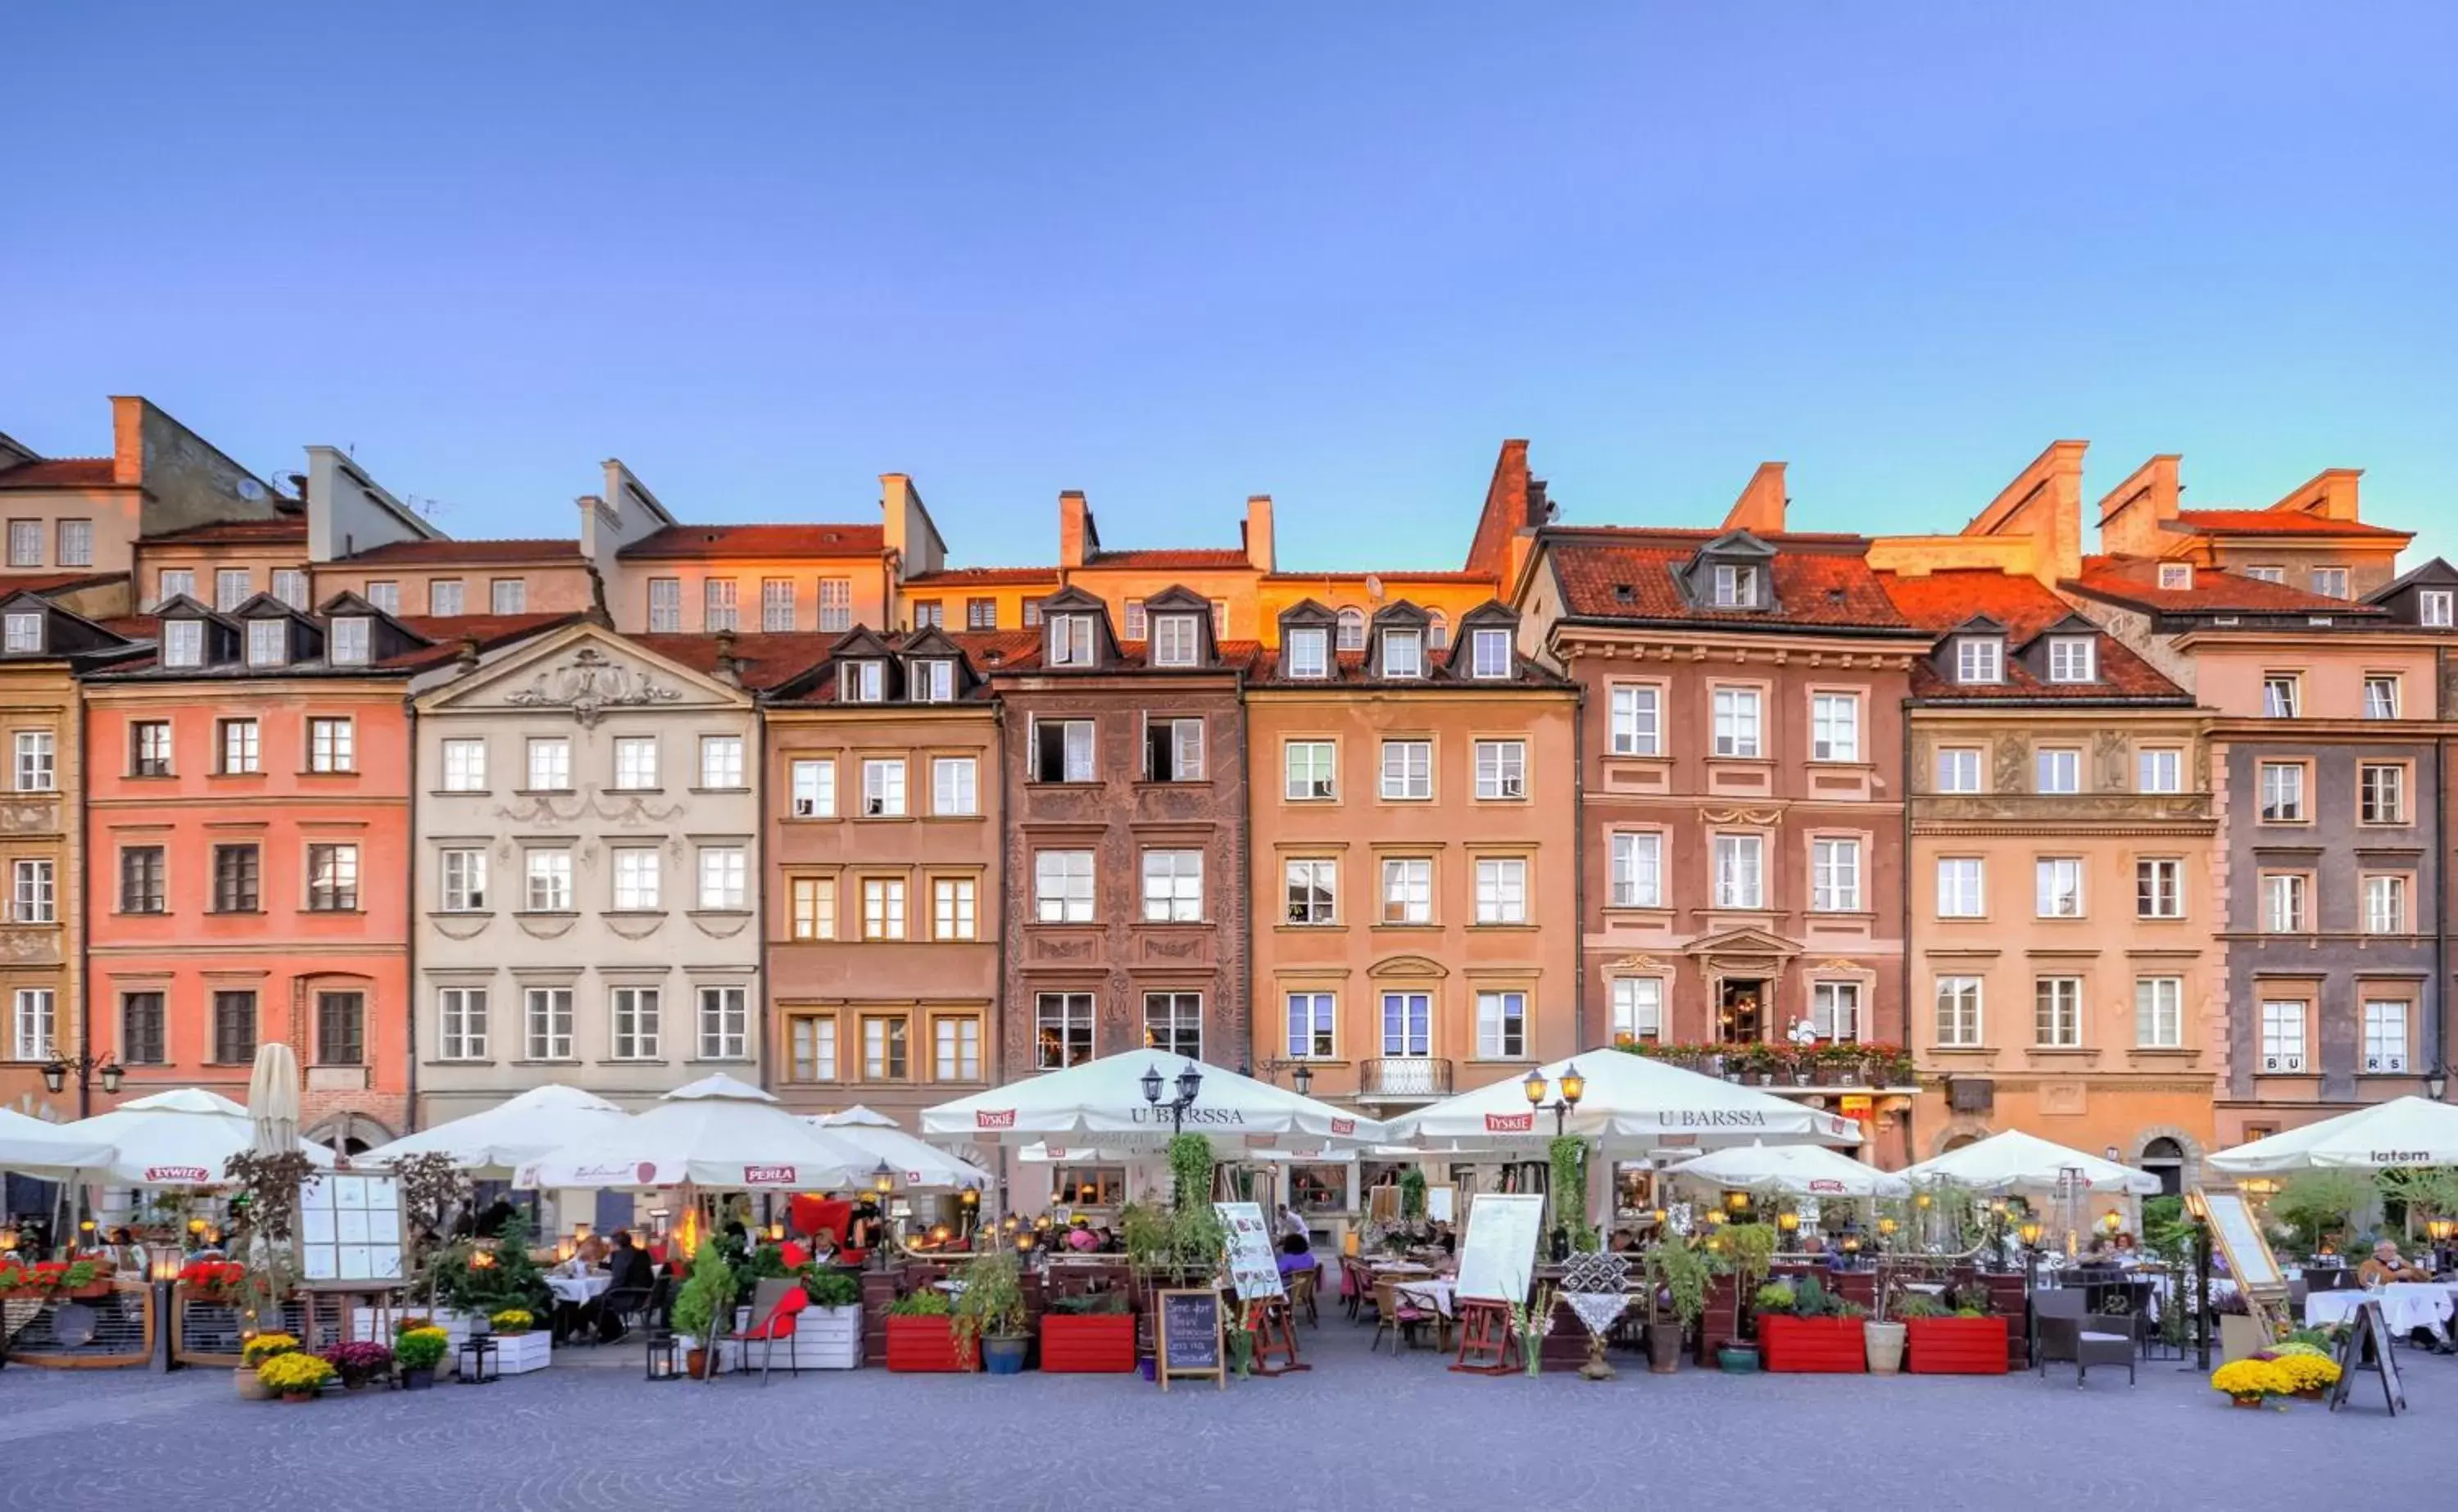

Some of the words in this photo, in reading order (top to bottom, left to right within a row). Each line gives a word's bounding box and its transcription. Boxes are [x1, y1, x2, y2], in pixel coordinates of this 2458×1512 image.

[979, 1113, 1013, 1125] TYSKIE
[1131, 1107, 1147, 1123] U
[1658, 1111, 1673, 1126] U
[1682, 1110, 1766, 1126] BARSSA
[1490, 1116, 1528, 1129] TYSKIE
[2370, 1149, 2429, 1161] latem
